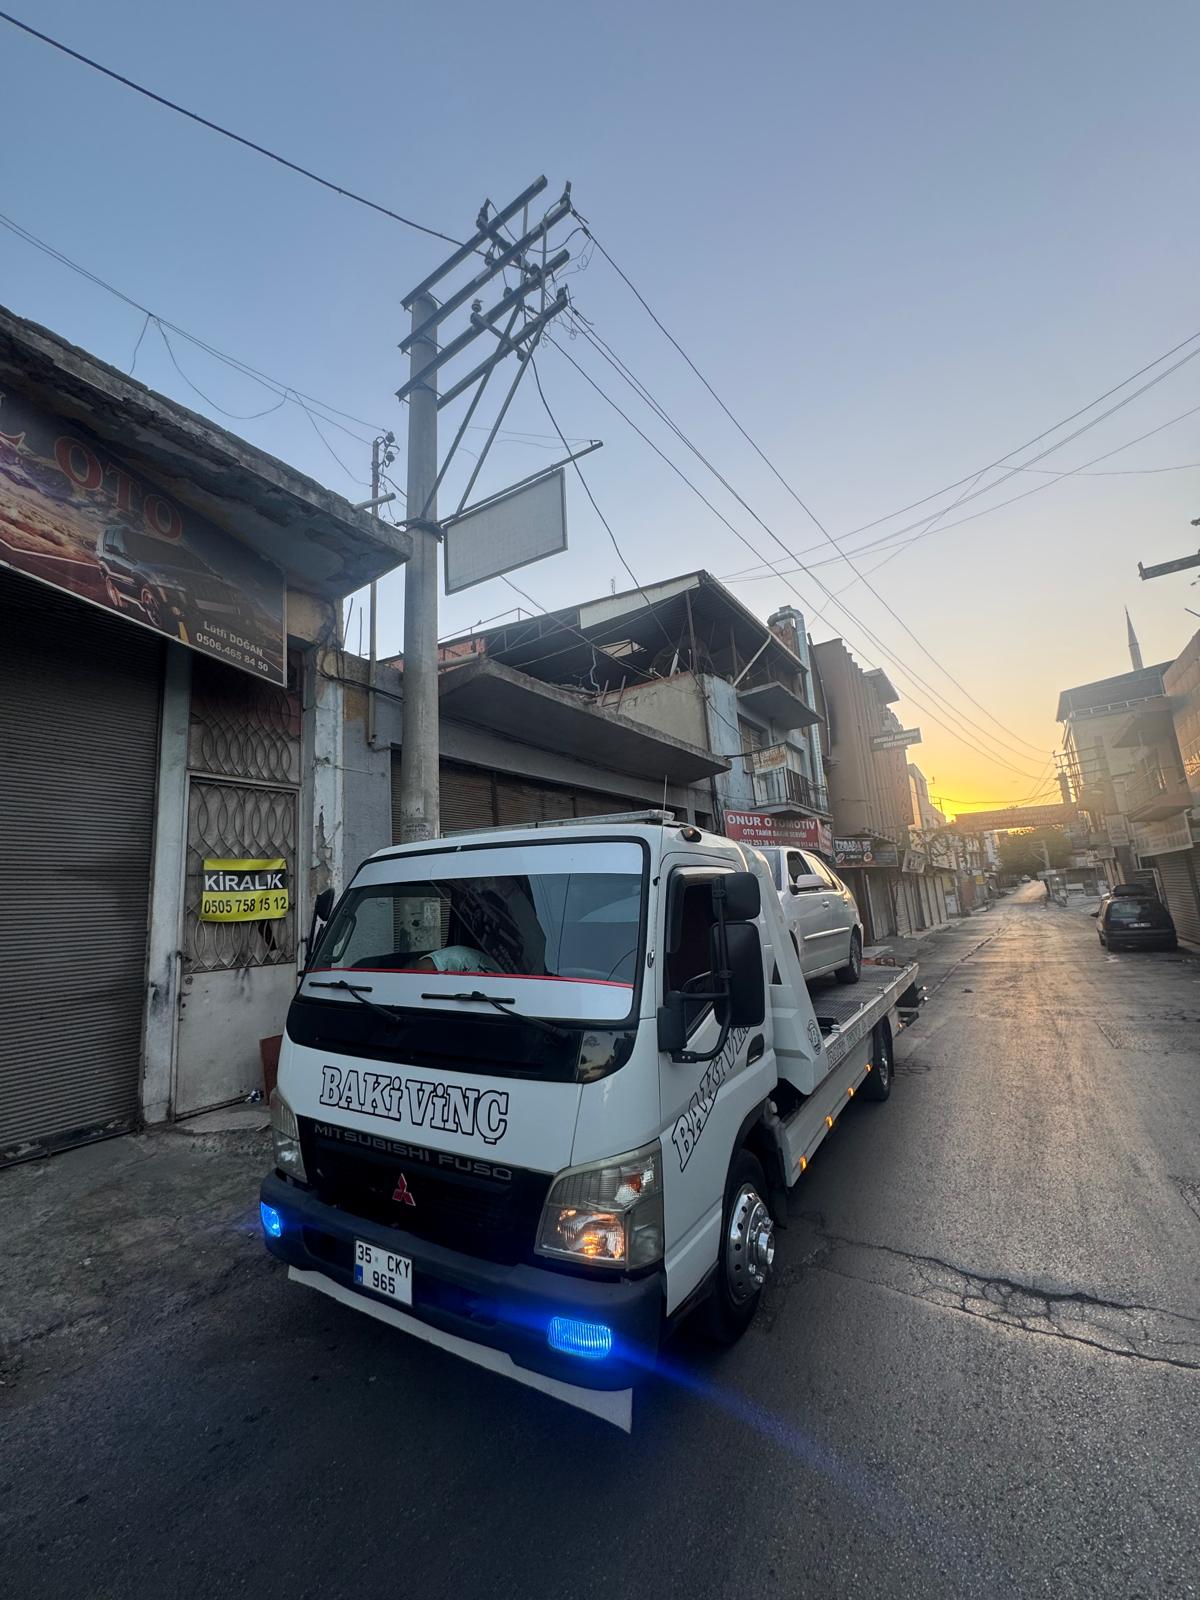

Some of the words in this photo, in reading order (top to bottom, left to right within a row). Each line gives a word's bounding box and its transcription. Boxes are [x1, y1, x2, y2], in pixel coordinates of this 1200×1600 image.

[54, 436, 183, 541] OTO
[257, 661, 269, 672] 50
[727, 815, 761, 826] ONUR
[764, 817, 815, 829] OTOMOTİV
[743, 828, 755, 836] OTO
[204, 872, 283, 891] KİRALIK
[204, 899, 232, 914] 0505
[235, 898, 256, 912] 758
[259, 897, 270, 911] 15
[274, 896, 287, 910] 12
[314, 1124, 430, 1162] MITSUBISHI
[438, 1154, 513, 1181] FUSO
[357, 1244, 372, 1264] 35
[387, 1255, 410, 1279] CKY
[372, 1270, 395, 1294] 965
